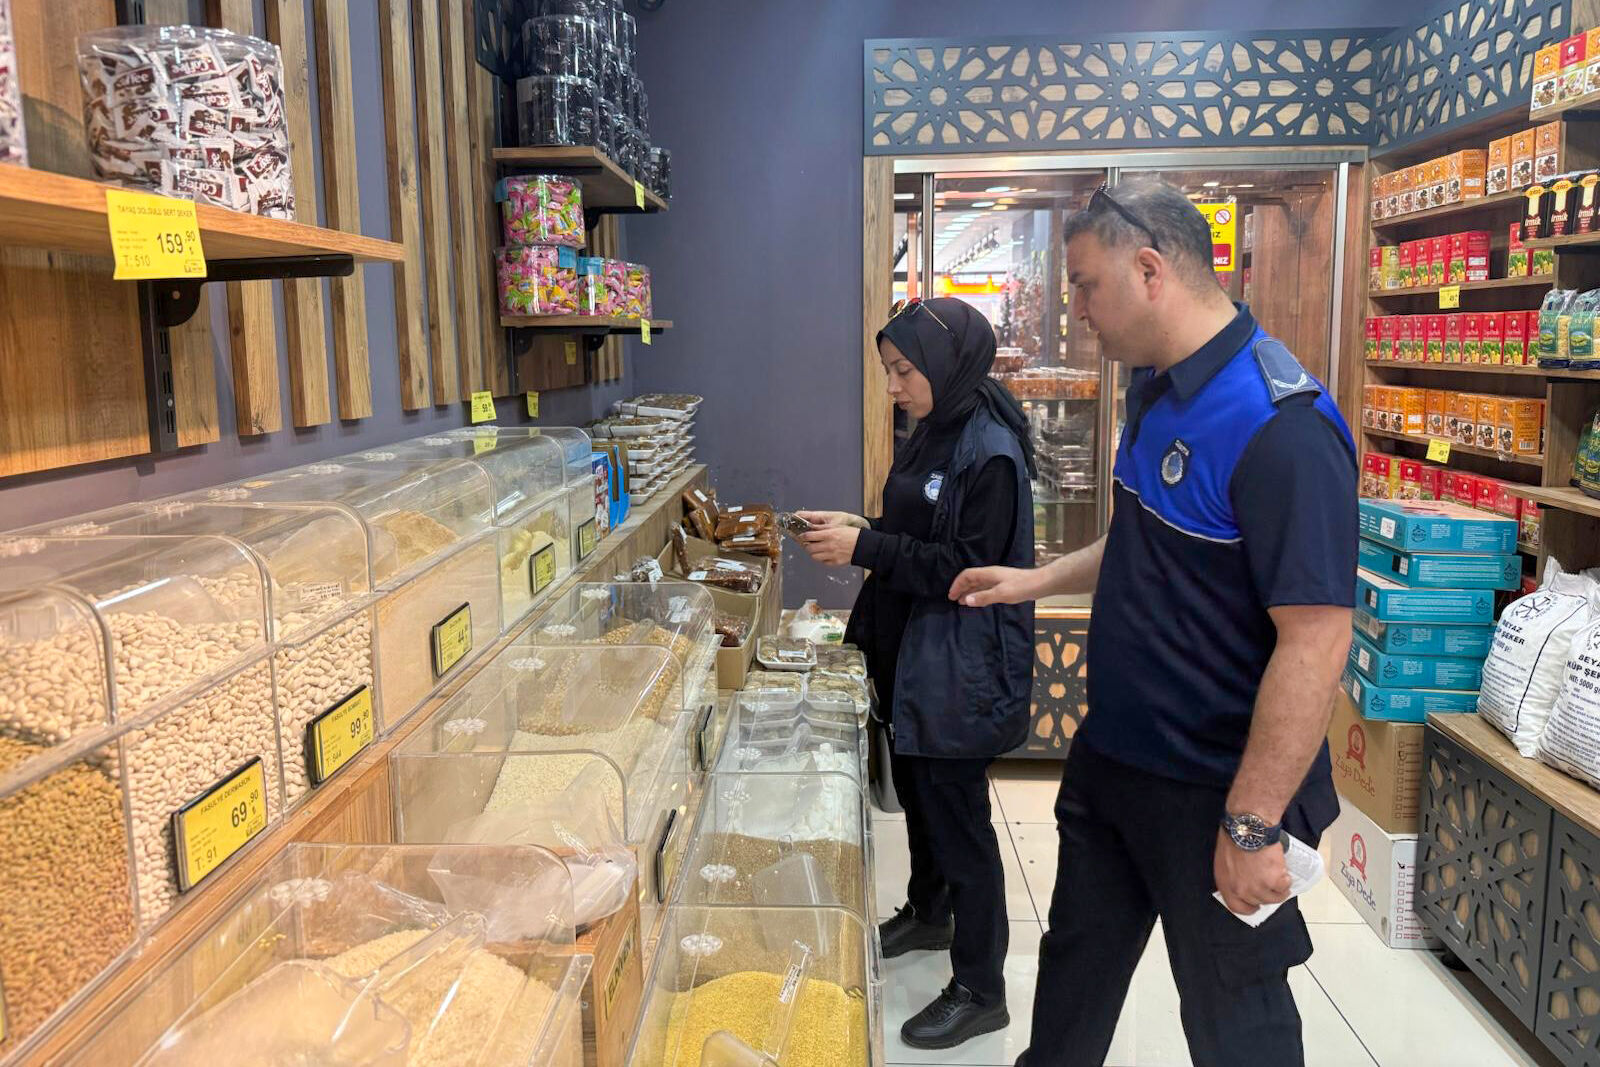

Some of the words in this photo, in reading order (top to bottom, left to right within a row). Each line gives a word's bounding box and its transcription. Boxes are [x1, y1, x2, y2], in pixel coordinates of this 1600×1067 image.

[157, 233, 184, 254] 159
[134, 254, 151, 267] 510
[458, 628, 465, 643] 44
[1502, 619, 1524, 634] BEYAZ
[1501, 630, 1526, 646] ŞEKER
[1566, 660, 1583, 672] KÜP
[1579, 678, 1594, 690] 5000
[350, 717, 361, 739] 99
[1335, 752, 1353, 779] Ziya
[1353, 767, 1376, 798] Dede
[201, 794, 224, 815] FASULYE
[231, 801, 248, 828] 69
[206, 845, 218, 863] 91
[1340, 860, 1356, 889] Ziya
[1357, 878, 1377, 912] Dede
